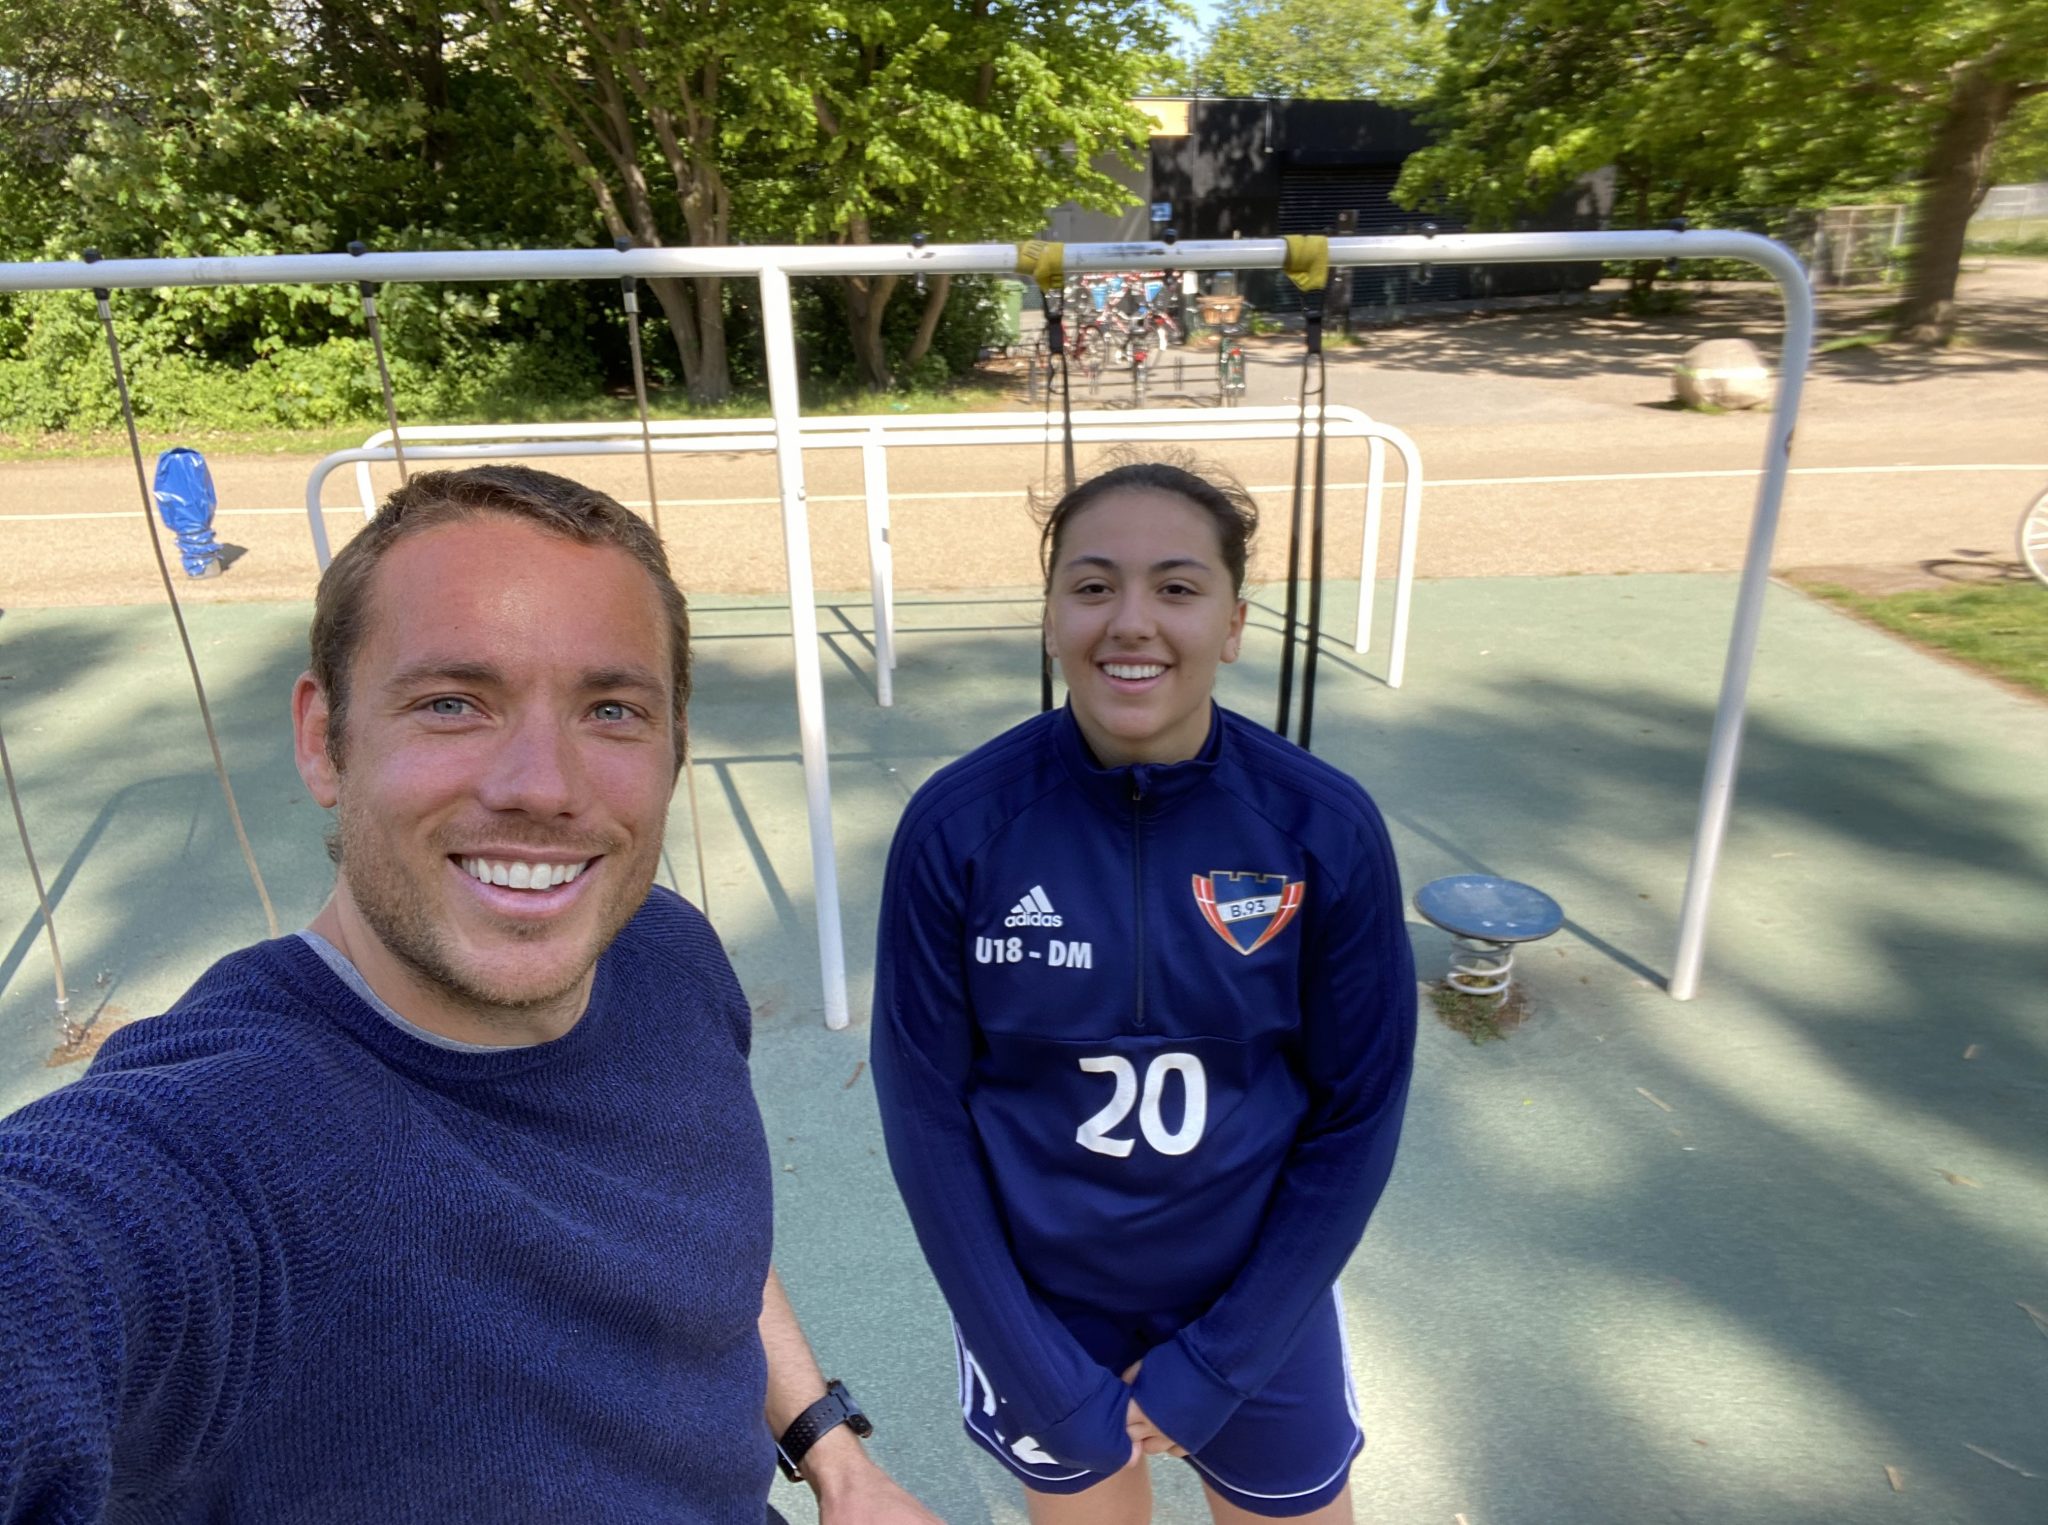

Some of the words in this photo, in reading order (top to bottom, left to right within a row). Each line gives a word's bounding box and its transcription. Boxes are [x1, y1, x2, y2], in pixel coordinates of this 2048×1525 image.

[1004, 911, 1063, 928] adidas
[1230, 900, 1267, 918] B.93
[975, 936, 1023, 964] U18
[1047, 940, 1092, 969] DM
[1075, 1052, 1207, 1158] 20
